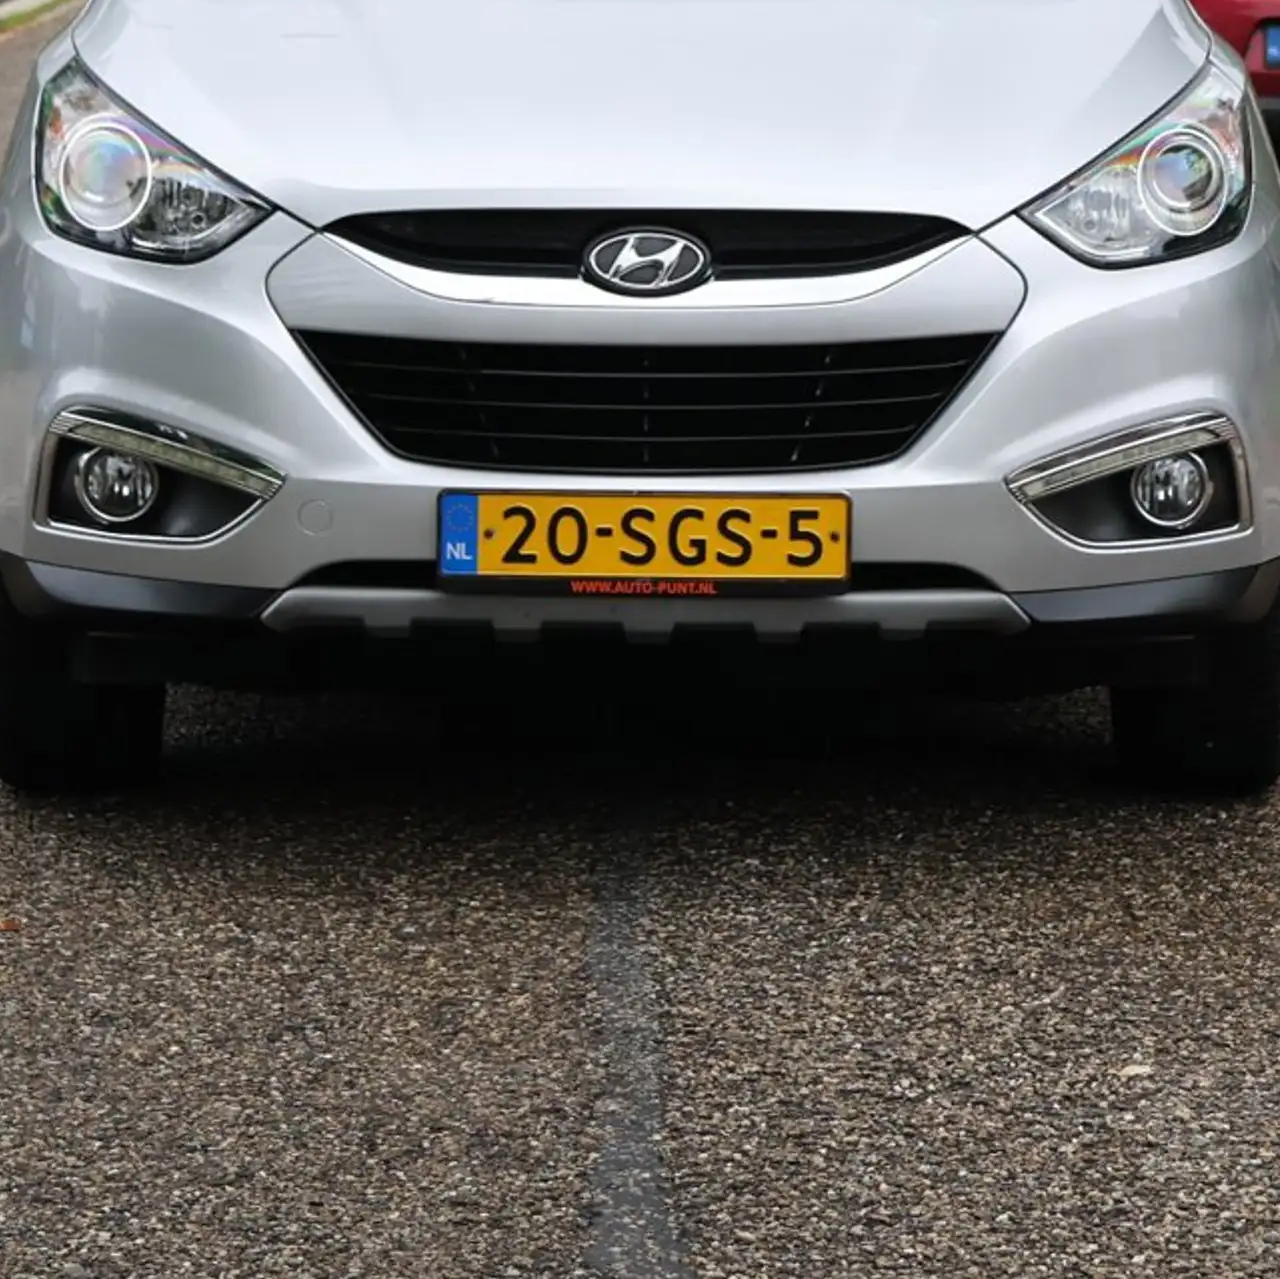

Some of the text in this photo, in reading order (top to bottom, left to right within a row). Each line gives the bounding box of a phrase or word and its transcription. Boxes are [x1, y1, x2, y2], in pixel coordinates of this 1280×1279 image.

[501, 506, 824, 567] 20-SGS-5
[446, 542, 473, 560] NL
[571, 579, 718, 595] WWW.AUTO-PUNT.NL
